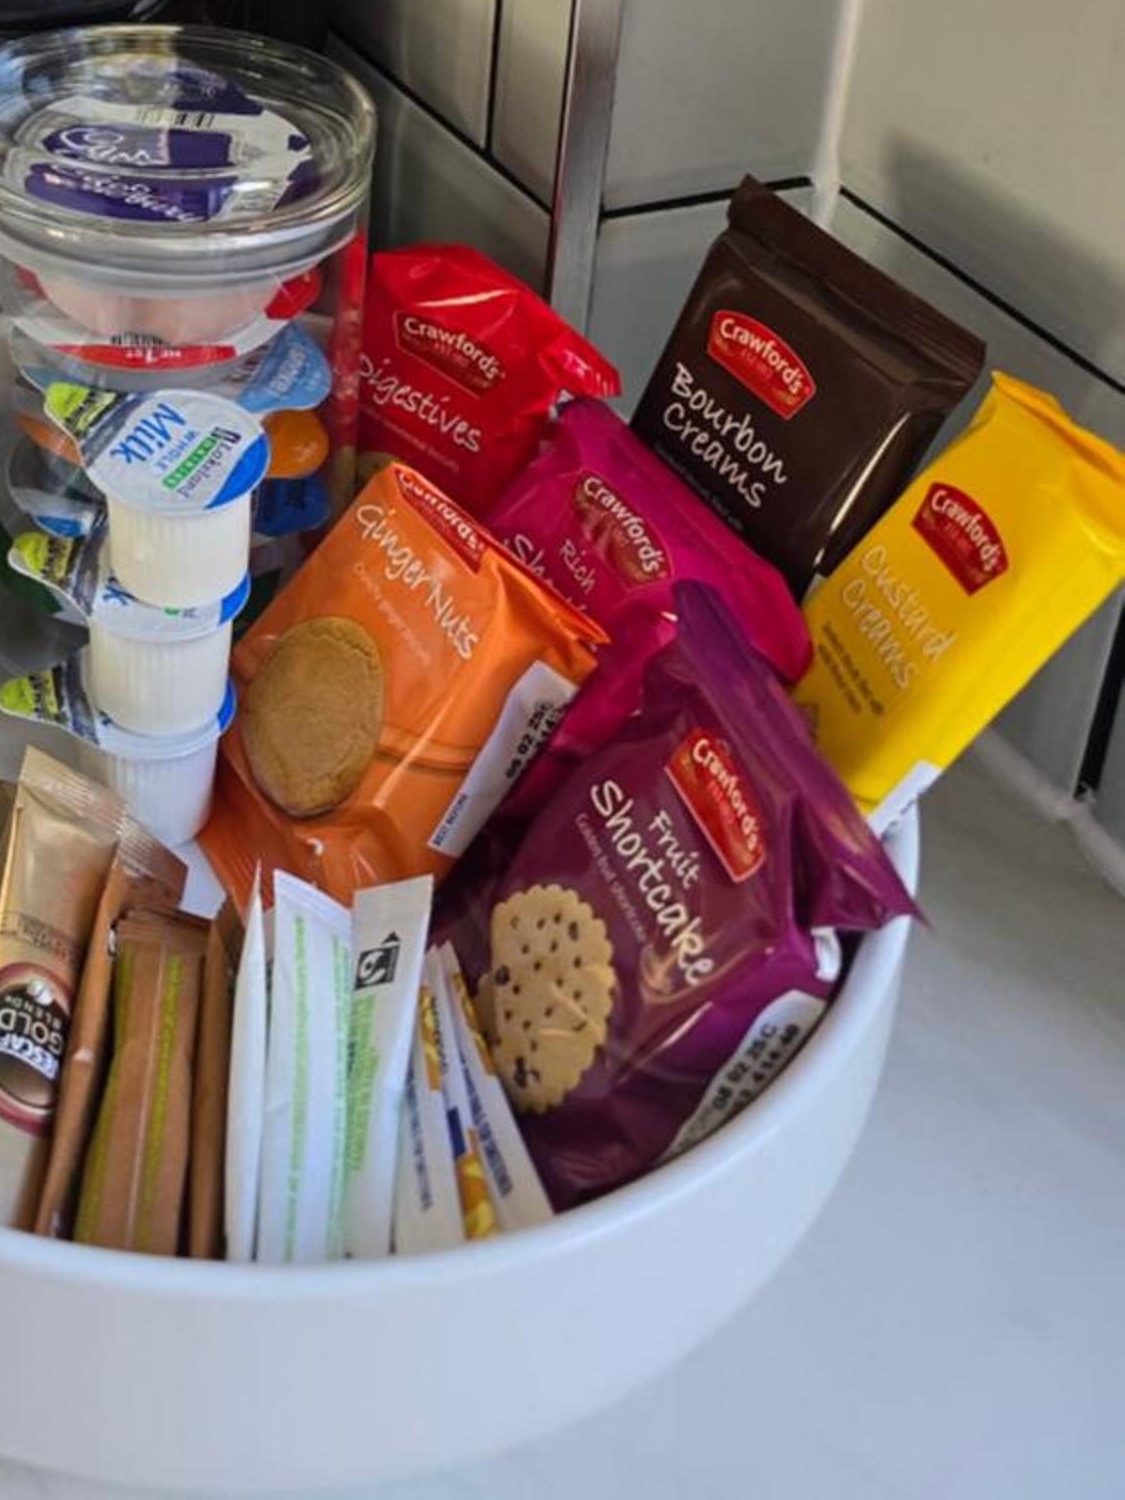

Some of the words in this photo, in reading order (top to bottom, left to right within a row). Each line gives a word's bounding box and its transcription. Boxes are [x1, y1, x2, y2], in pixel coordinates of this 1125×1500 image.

[404, 316, 502, 379] Crawford's
[719, 318, 804, 394] Crawford's
[108, 403, 186, 464] Milk
[663, 402, 766, 508] Creams
[671, 361, 787, 484] Bourbon
[559, 539, 596, 594] Rich
[584, 476, 665, 573] Crawford's
[931, 489, 1001, 572] Crawford's
[356, 504, 427, 590] Ginger
[425, 580, 479, 660] Nuts
[861, 545, 956, 664] Custard
[842, 579, 918, 689] Creams
[691, 738, 759, 852] Crawford's
[590, 780, 714, 987] Shortcake
[648, 810, 700, 889] Fruit
